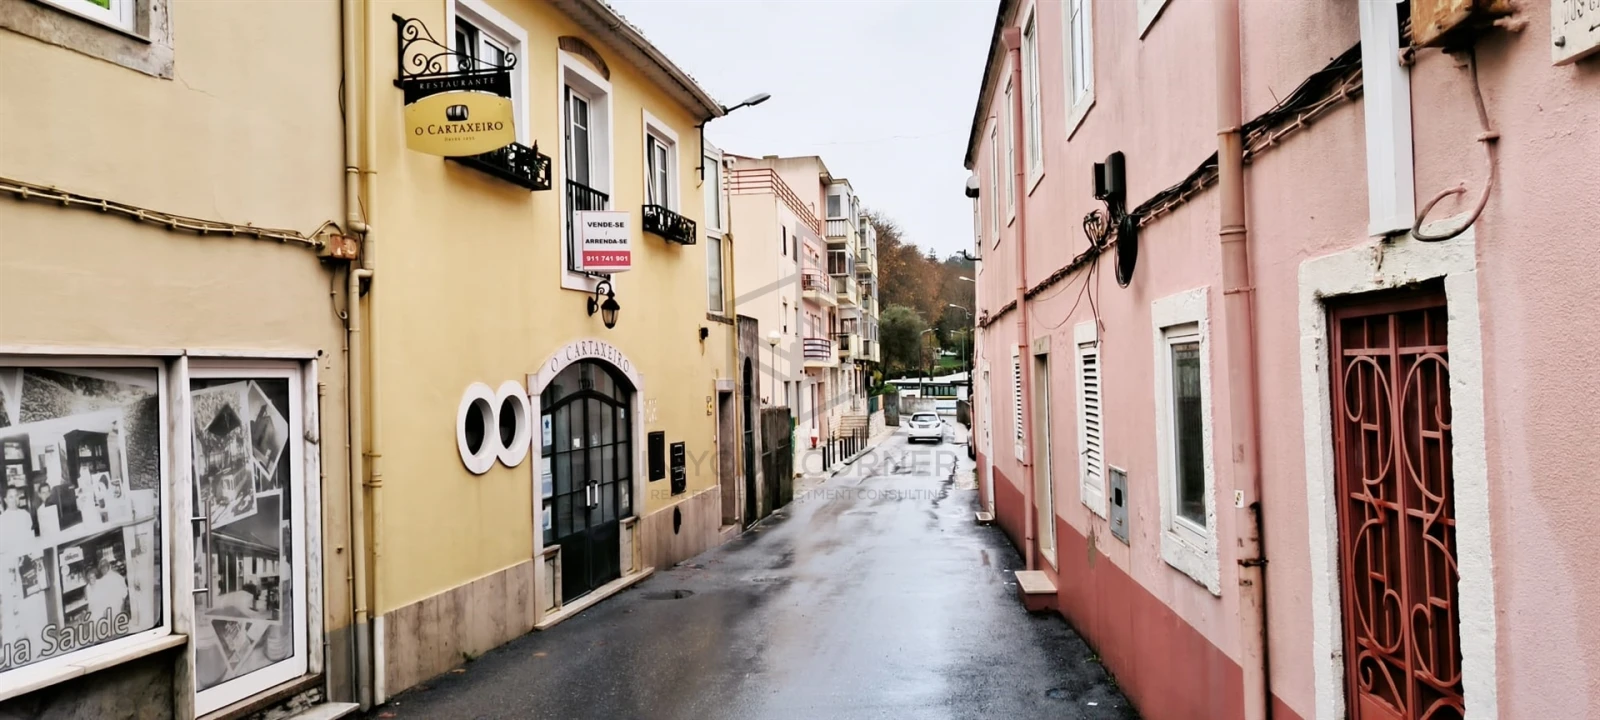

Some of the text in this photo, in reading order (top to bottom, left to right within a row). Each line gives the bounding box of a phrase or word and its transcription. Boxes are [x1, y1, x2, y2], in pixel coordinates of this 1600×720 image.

[420, 77, 496, 90] RESTAURANTE
[414, 121, 504, 136] O CARTAXEIRO
[550, 340, 630, 373] O CARTAXEIRO
[40, 607, 130, 657] Saúde
